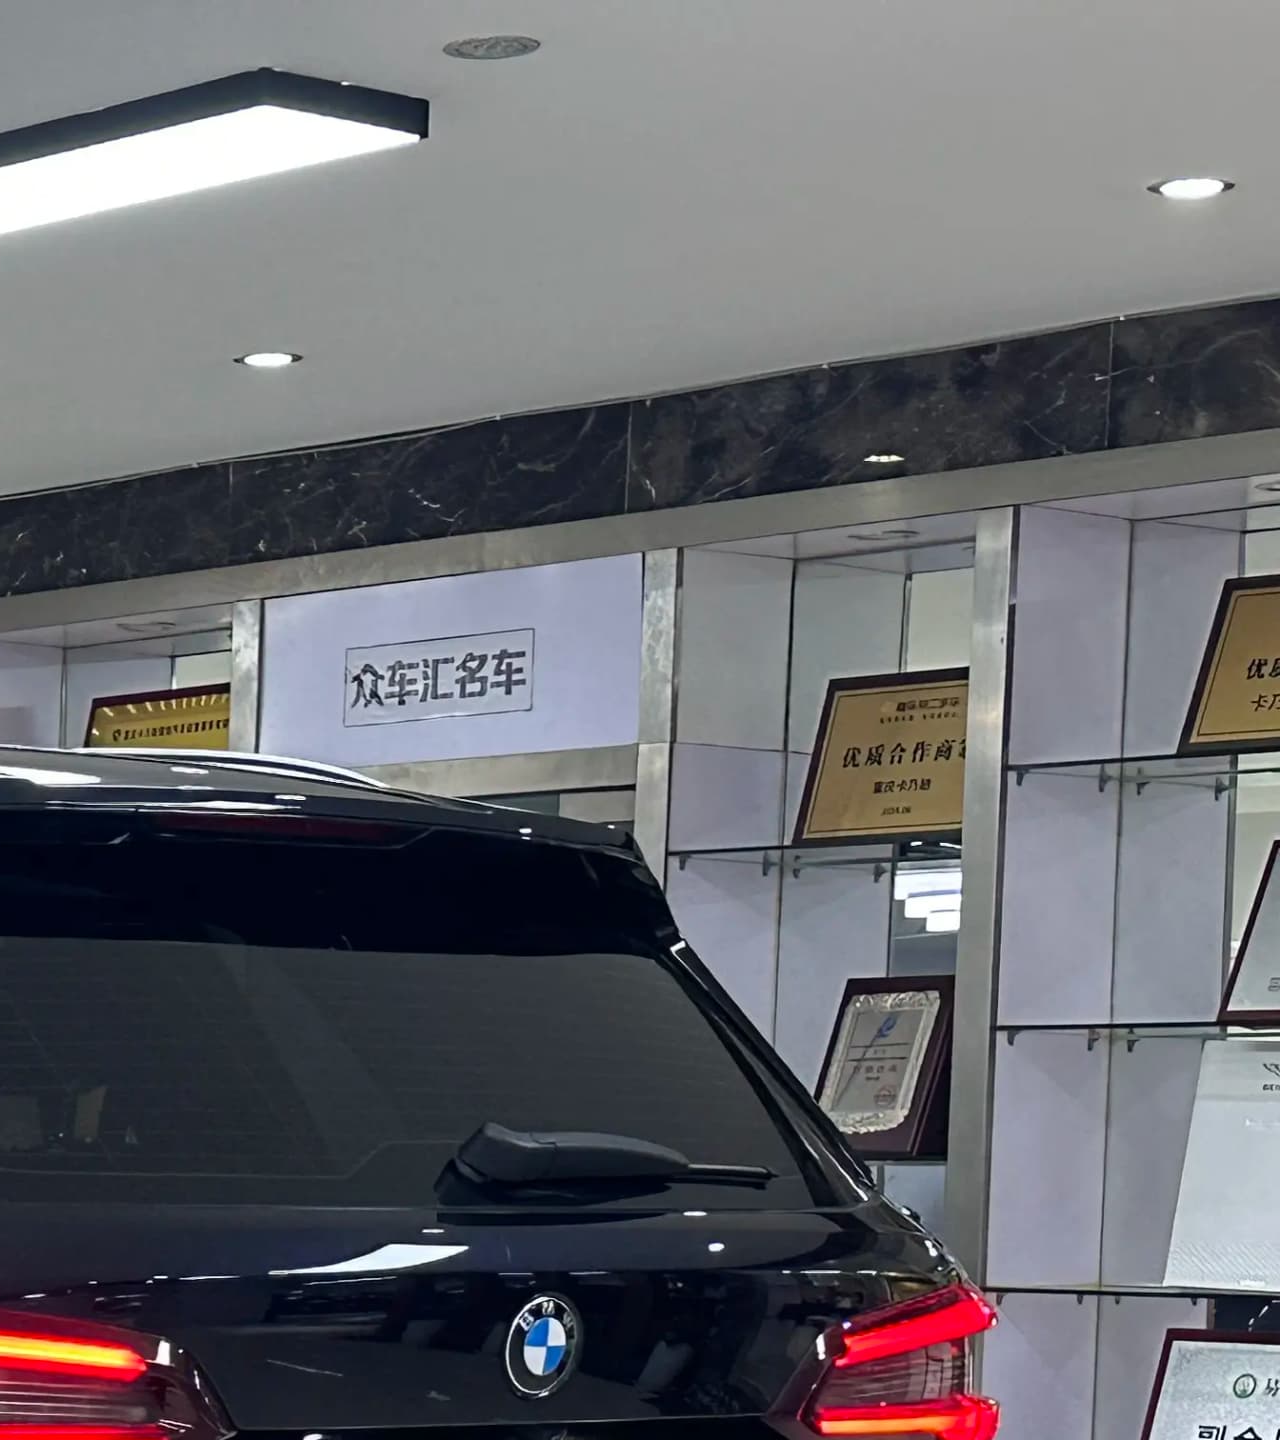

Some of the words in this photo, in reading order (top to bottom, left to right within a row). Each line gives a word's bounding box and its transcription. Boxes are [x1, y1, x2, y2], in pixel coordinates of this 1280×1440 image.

[350, 648, 527, 708] 众车汇名车
